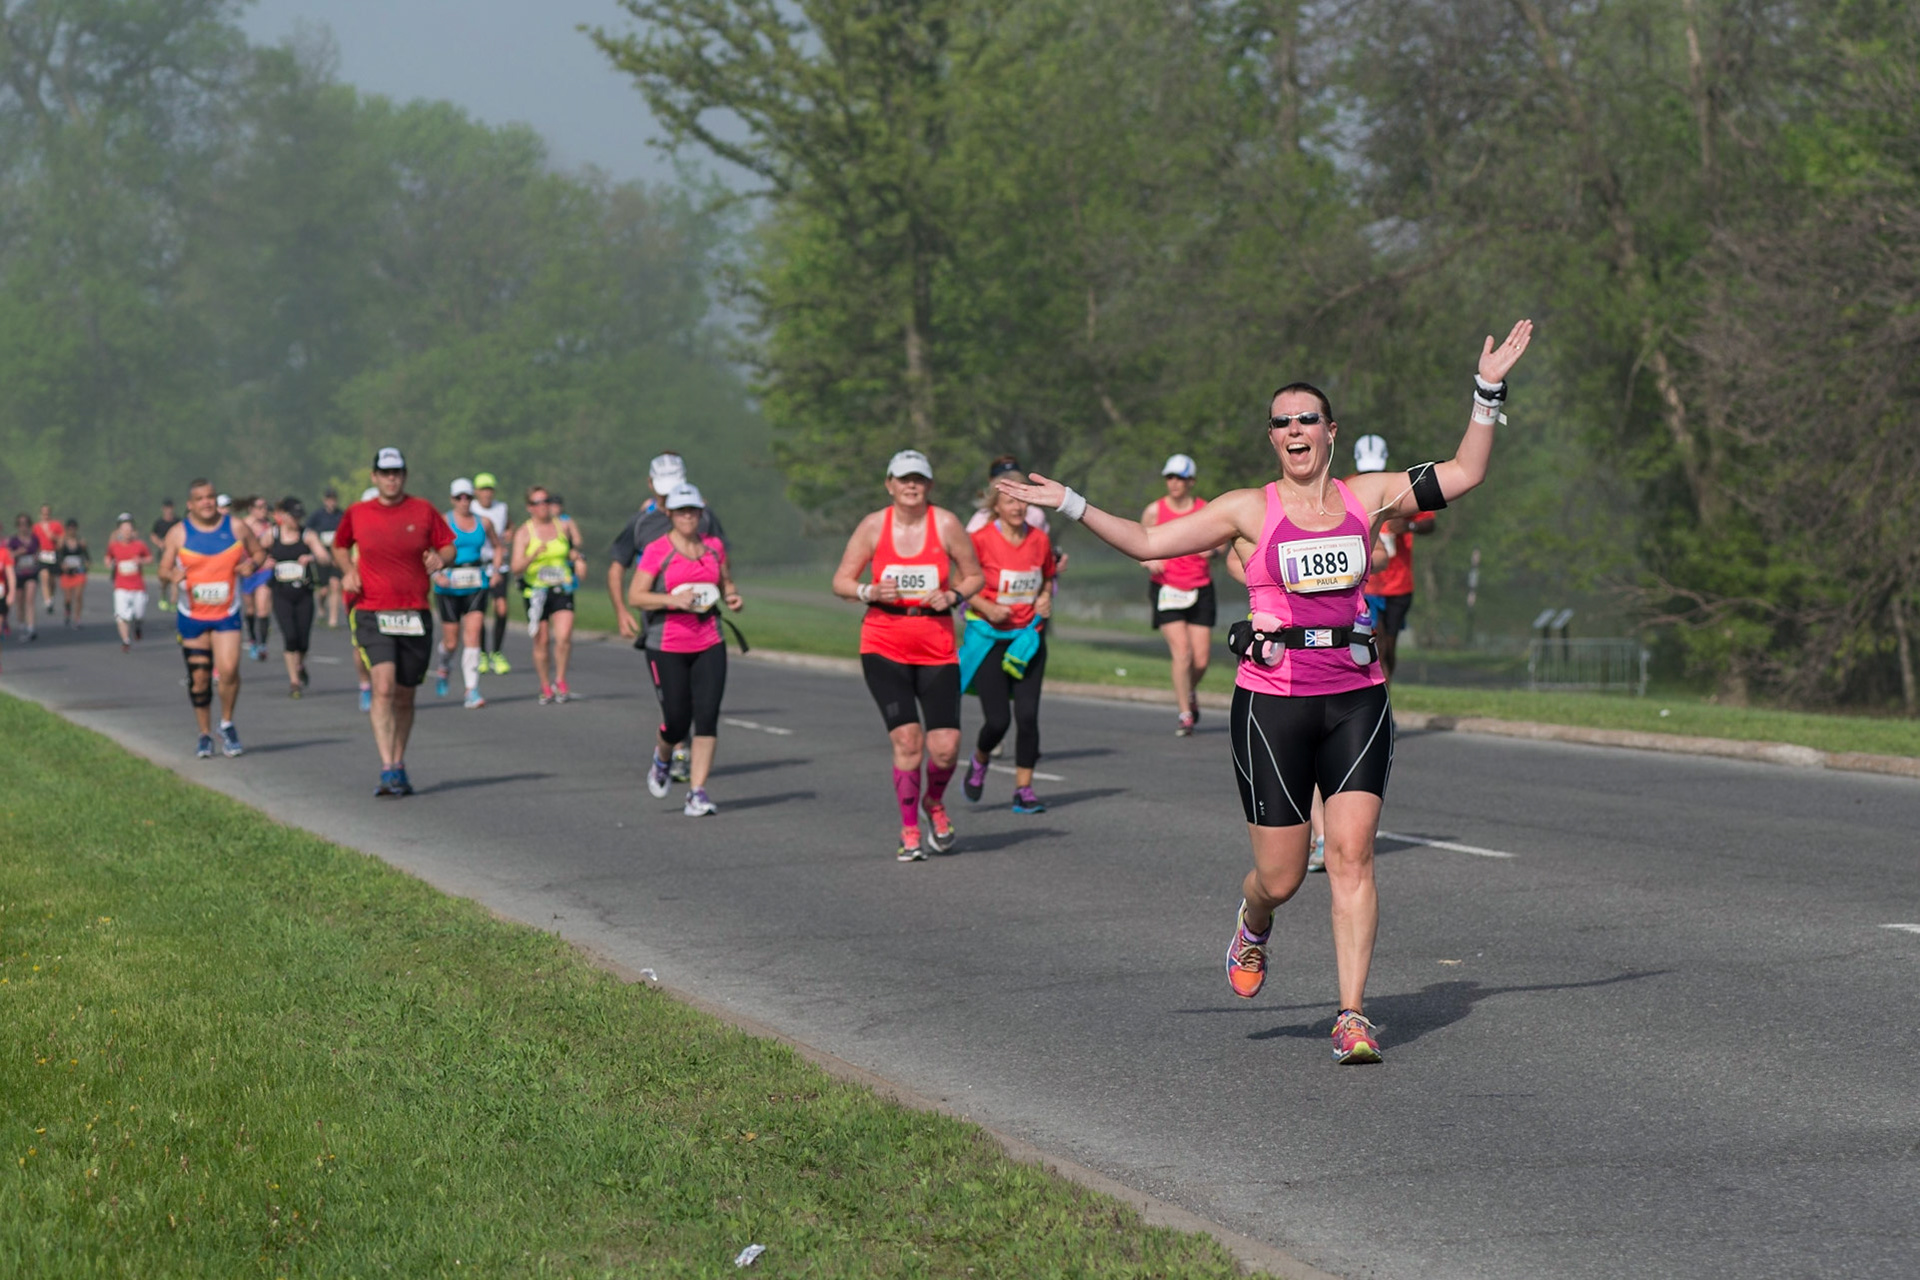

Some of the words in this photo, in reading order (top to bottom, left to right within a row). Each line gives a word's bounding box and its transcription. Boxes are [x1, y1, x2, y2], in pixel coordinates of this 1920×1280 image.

[1301, 551, 1349, 577] 1889
[895, 574, 925, 588] 1605
[1316, 578, 1338, 586] PAULA
